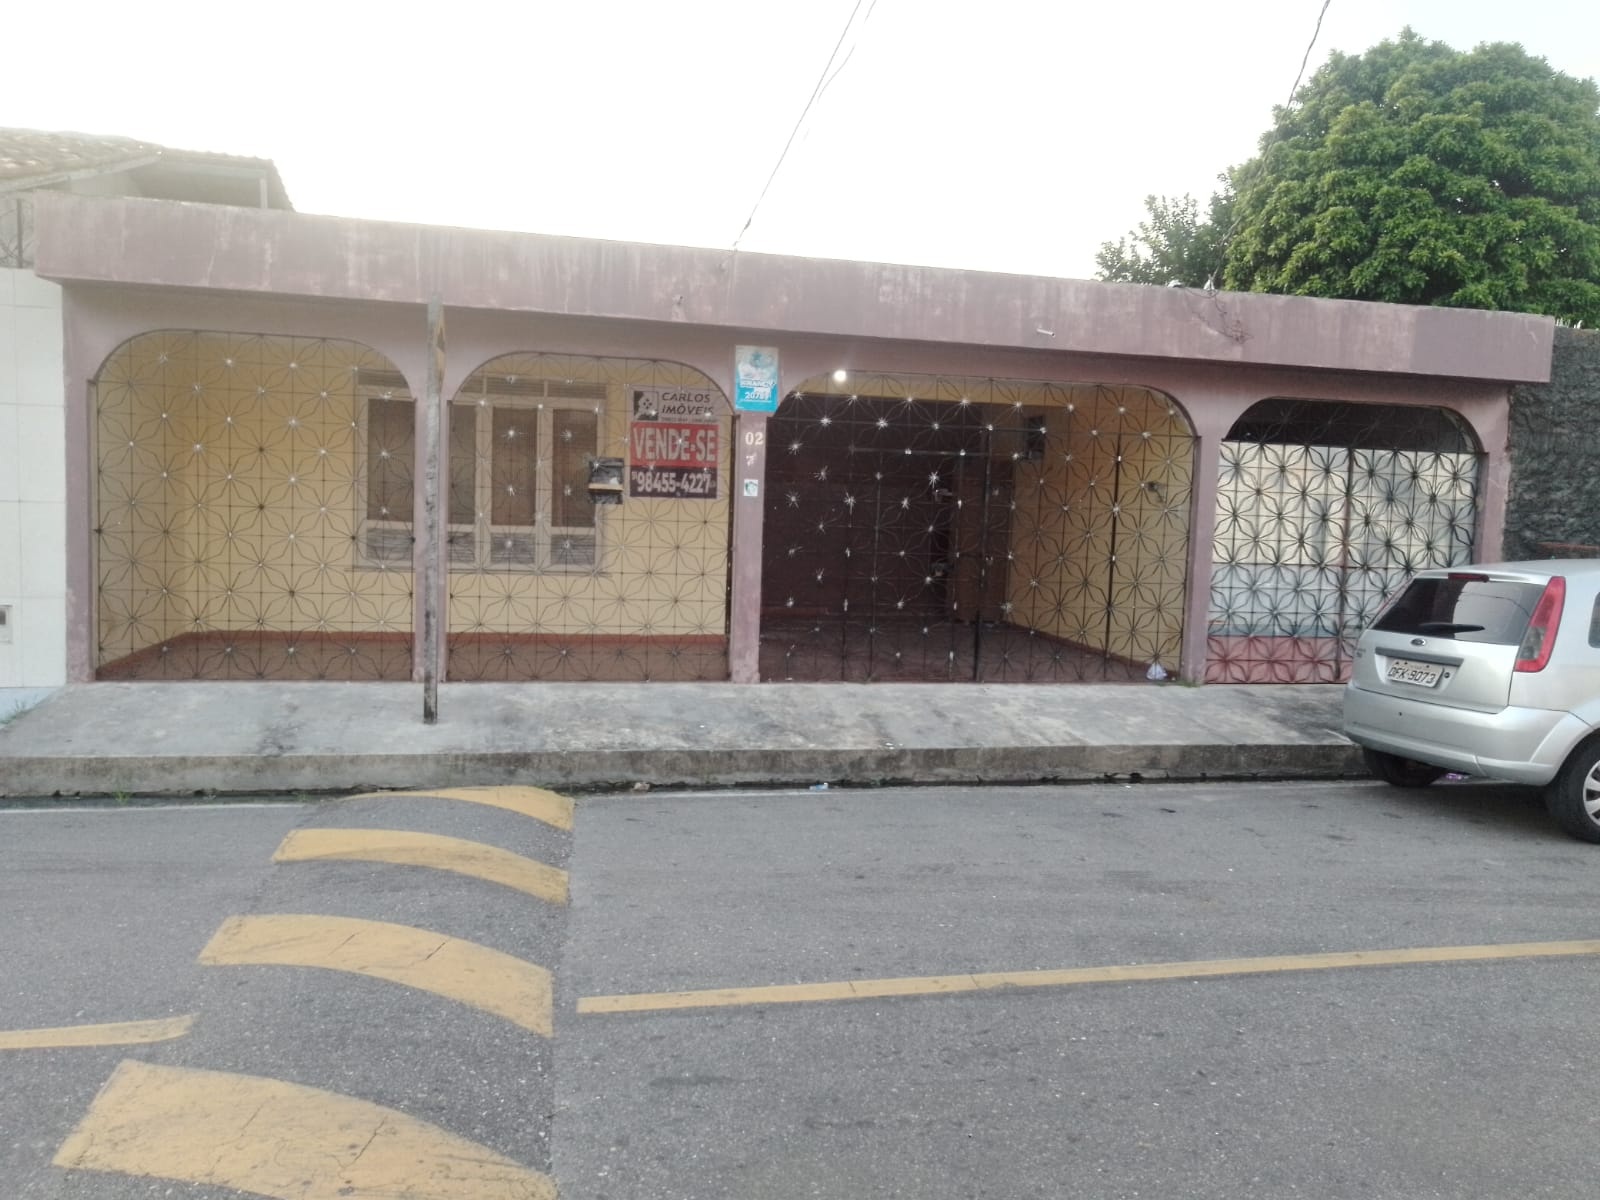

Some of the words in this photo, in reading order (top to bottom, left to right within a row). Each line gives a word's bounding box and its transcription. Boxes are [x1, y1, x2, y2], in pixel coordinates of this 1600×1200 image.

[662, 393, 711, 403] CARLOS
[633, 428, 716, 461] VENDE-SE
[745, 432, 763, 446] 02
